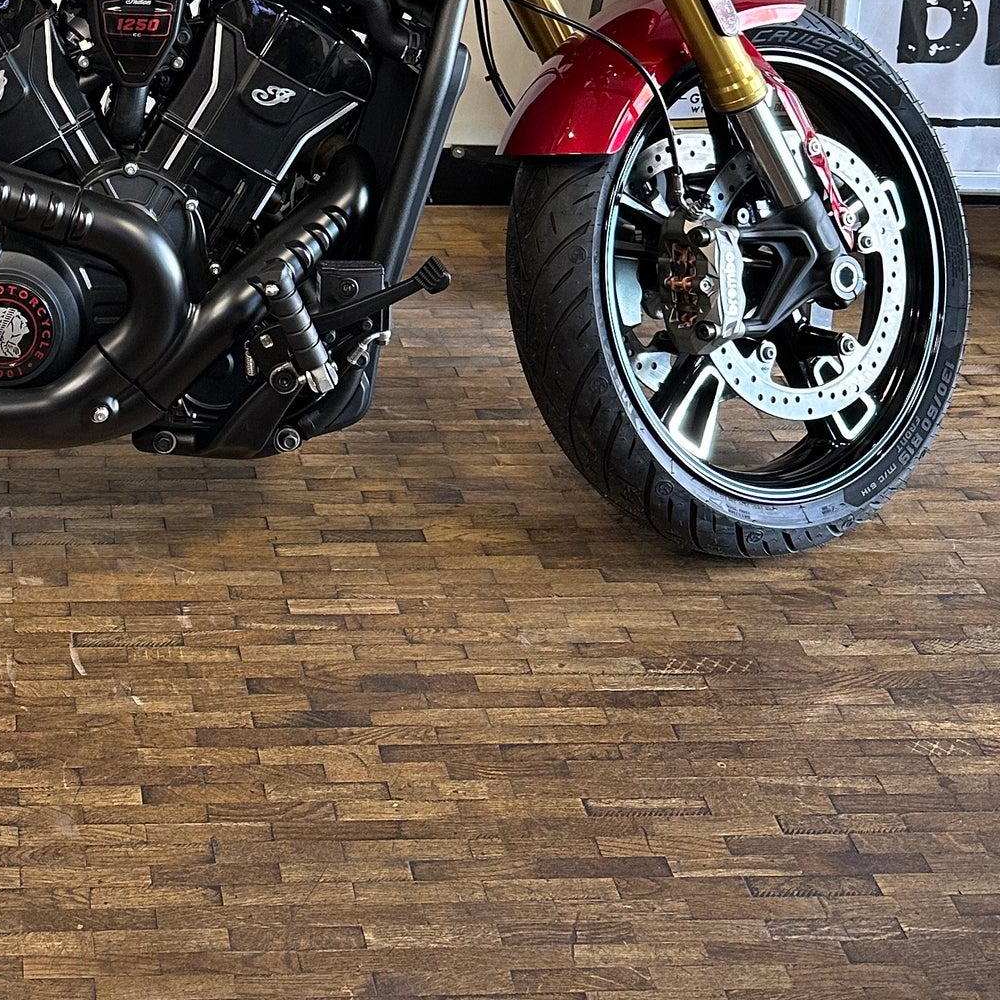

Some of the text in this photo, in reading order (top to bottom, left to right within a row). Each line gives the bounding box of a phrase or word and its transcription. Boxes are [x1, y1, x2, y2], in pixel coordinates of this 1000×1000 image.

[116, 18, 160, 31] 1250
[751, 29, 893, 93] CRUISETEC
[723, 251, 738, 317] brembo
[895, 414, 922, 454] FRONT
